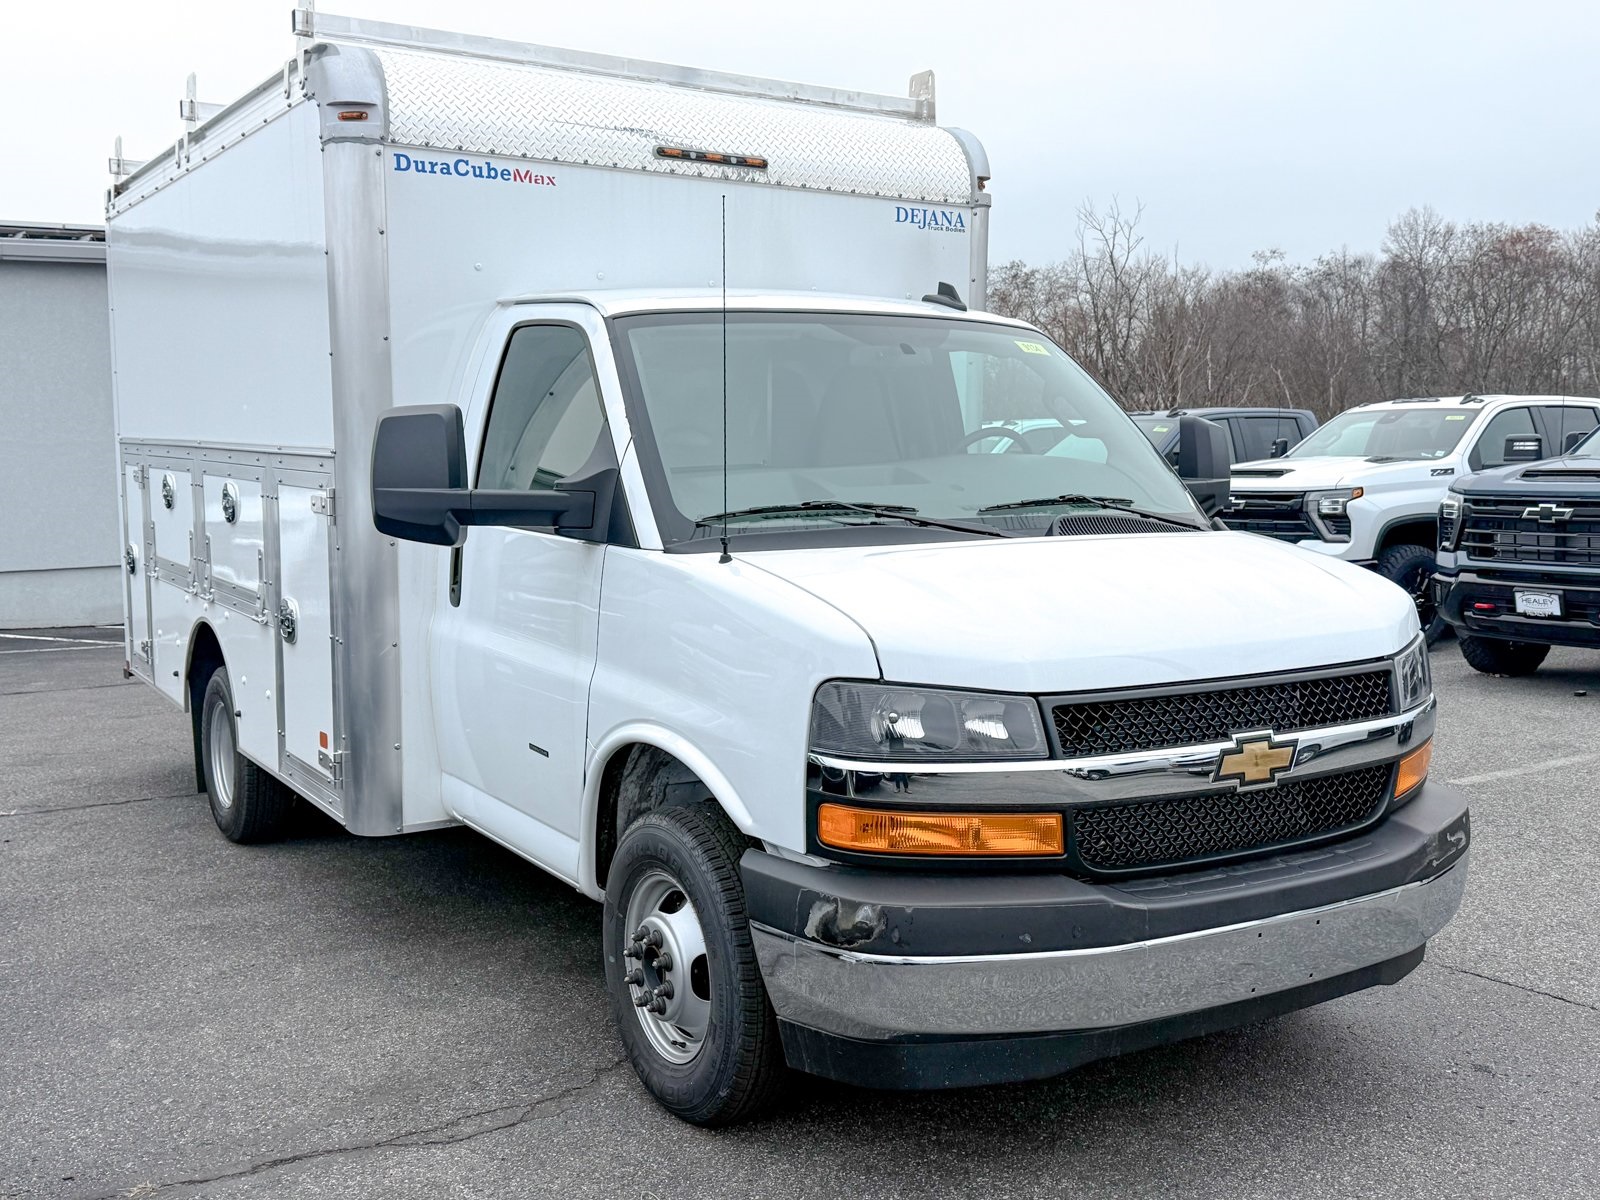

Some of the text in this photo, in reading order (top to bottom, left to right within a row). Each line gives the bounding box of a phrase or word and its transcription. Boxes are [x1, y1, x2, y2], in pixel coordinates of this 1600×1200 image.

[895, 206, 965, 229] DEJANA
[927, 223, 966, 234] Truck Bodies
[1521, 597, 1554, 606] HEALEY
